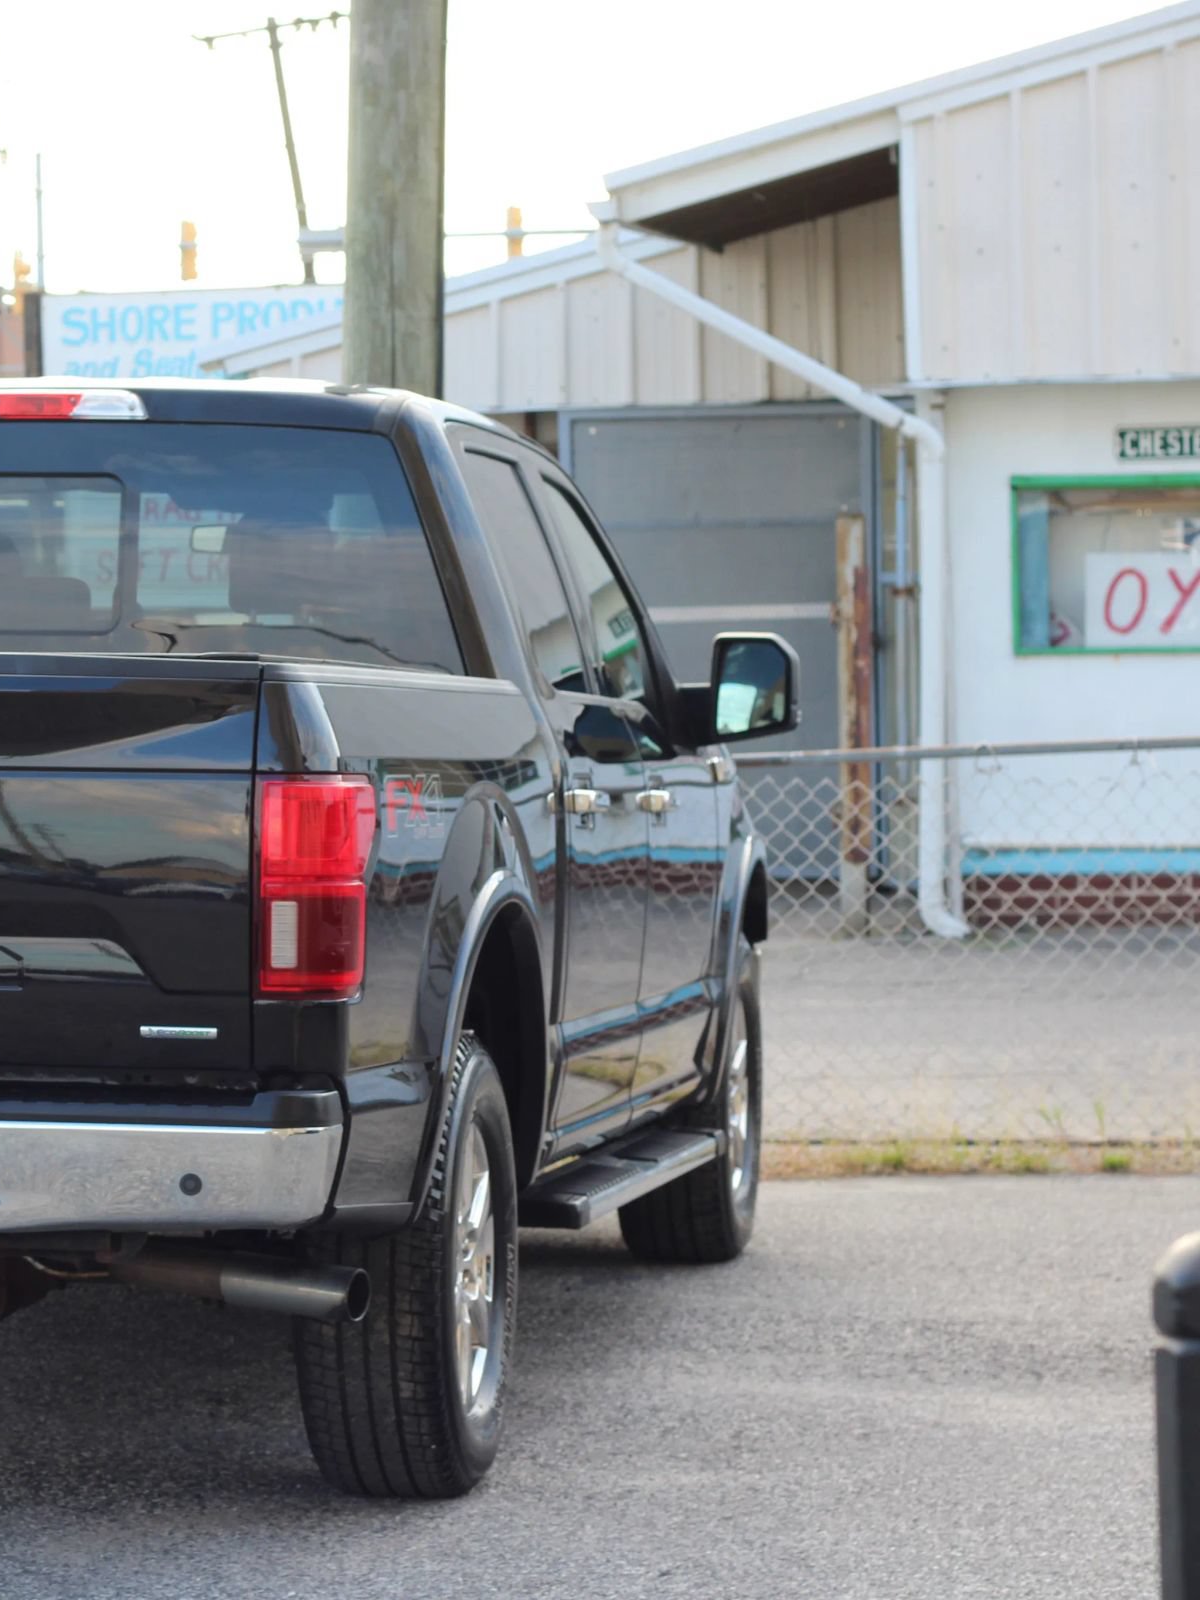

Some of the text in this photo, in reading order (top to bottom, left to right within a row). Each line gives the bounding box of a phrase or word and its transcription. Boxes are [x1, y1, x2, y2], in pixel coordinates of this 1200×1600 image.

[60, 302, 198, 347] SHORE
[1103, 565, 1200, 636] OY
[384, 774, 444, 838] FX4
